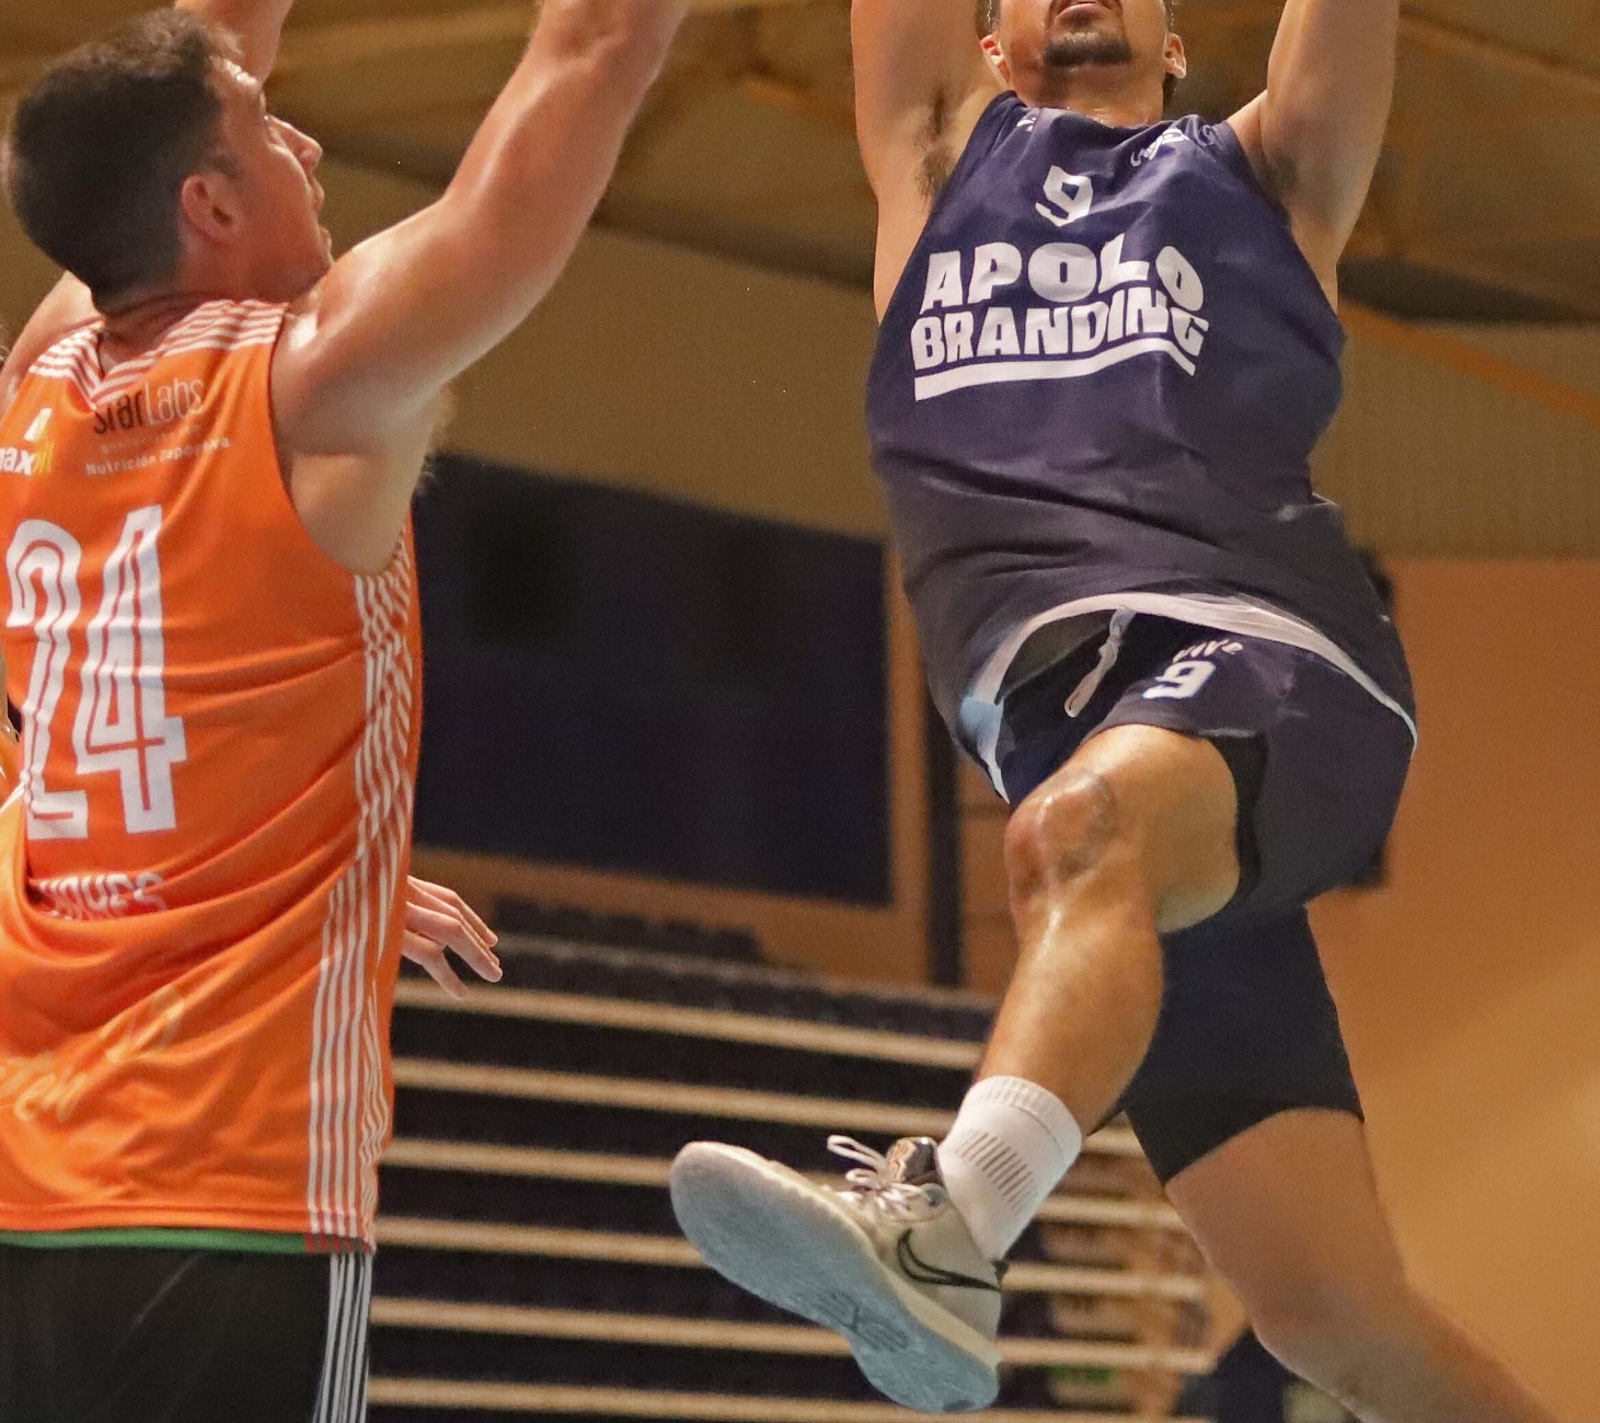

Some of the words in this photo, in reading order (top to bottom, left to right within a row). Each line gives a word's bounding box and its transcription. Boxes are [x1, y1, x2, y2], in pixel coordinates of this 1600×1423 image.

[1035, 165, 1093, 227] 9
[919, 233, 1204, 314] APOLO
[910, 287, 1209, 371] BRANDING
[6, 504, 187, 840] 24
[1142, 660, 1217, 700] 9
